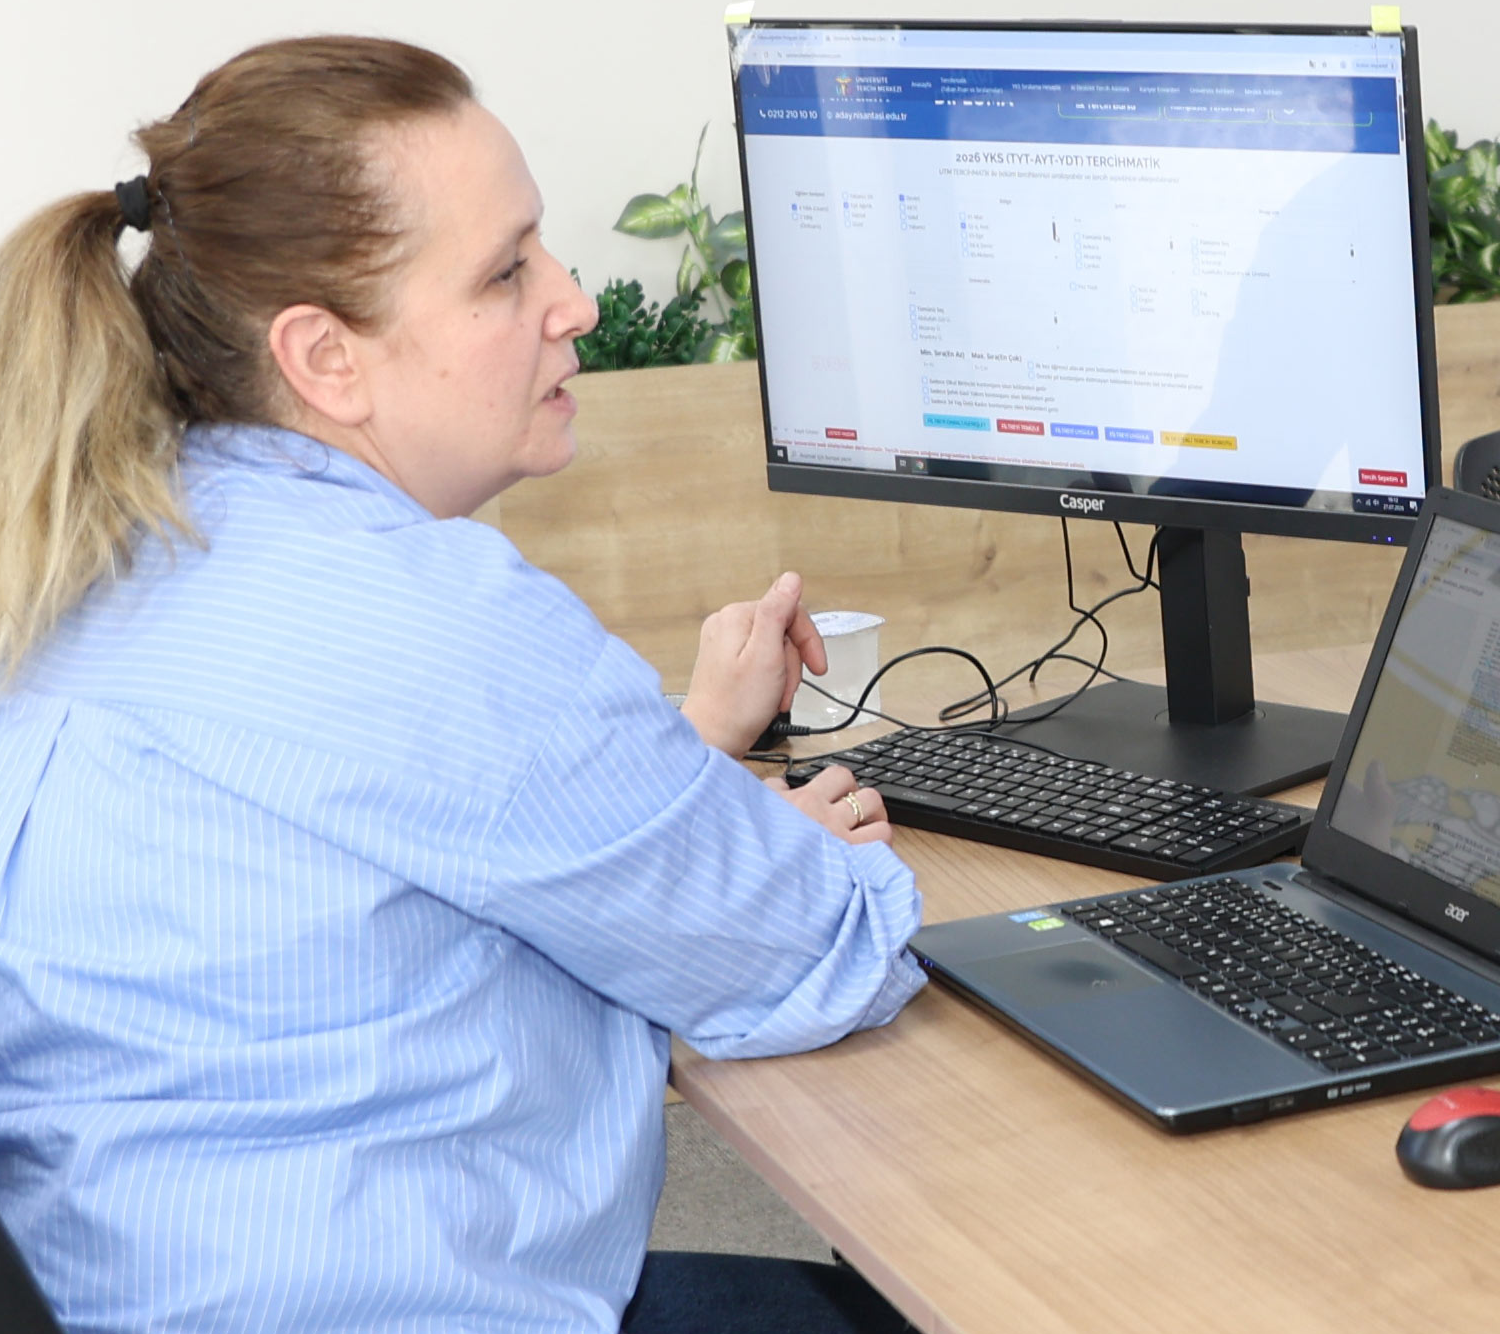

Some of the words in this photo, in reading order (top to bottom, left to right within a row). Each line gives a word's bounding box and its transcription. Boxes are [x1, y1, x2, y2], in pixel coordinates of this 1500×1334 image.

[982, 152, 1004, 164] YKS
[1006, 153, 1084, 167] (TYT-AYT-YDT)
[1087, 153, 1161, 169] TERCİHMATİK
[1059, 493, 1105, 514] Casper
[1444, 902, 1470, 923] acer
